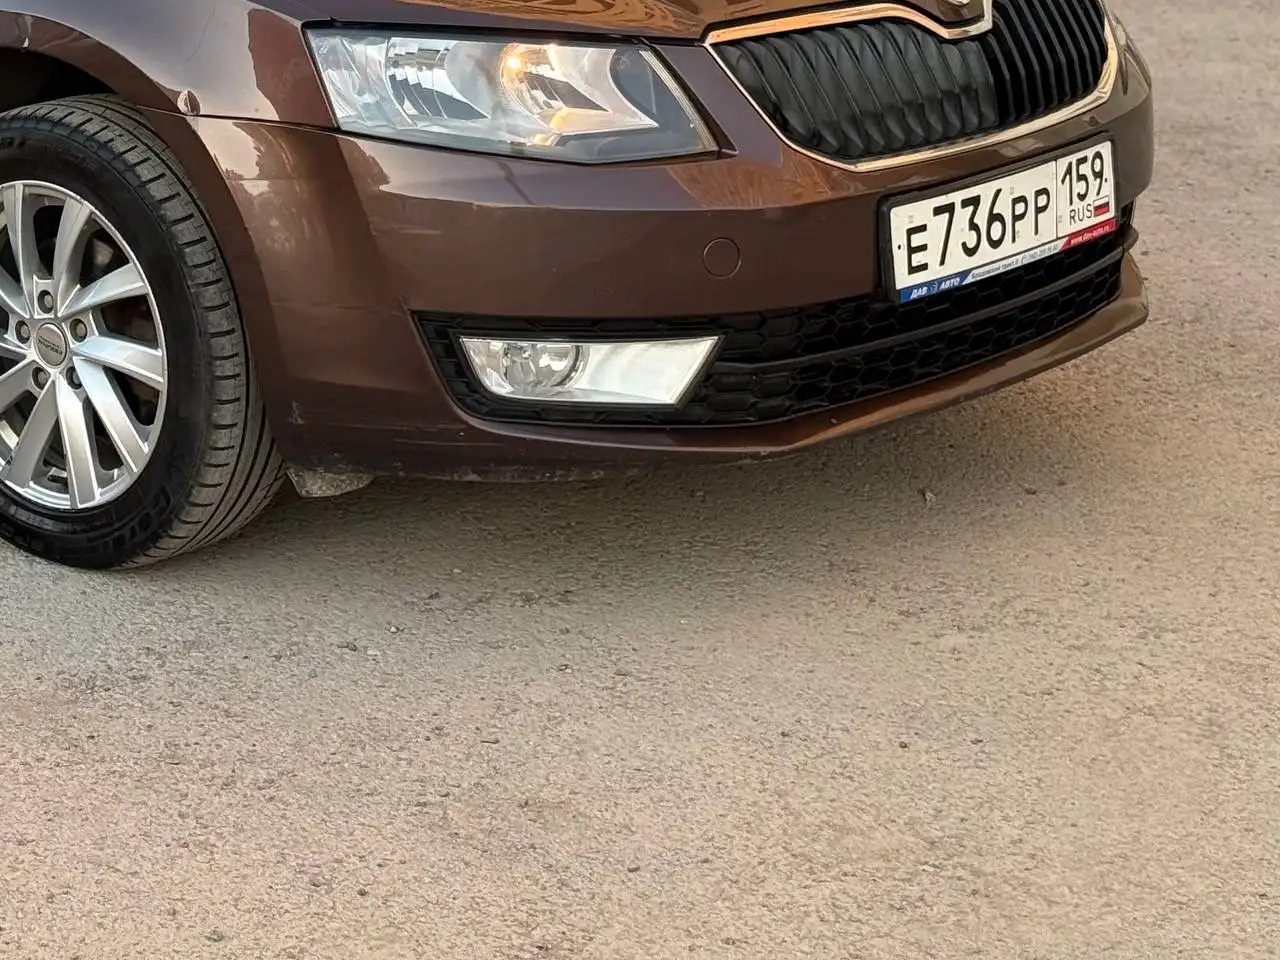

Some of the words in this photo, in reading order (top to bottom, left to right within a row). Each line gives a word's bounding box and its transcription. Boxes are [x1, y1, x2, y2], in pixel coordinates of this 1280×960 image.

[1061, 150, 1105, 207] 159
[1069, 204, 1093, 225] RUS
[939, 277, 961, 291] АВТО
